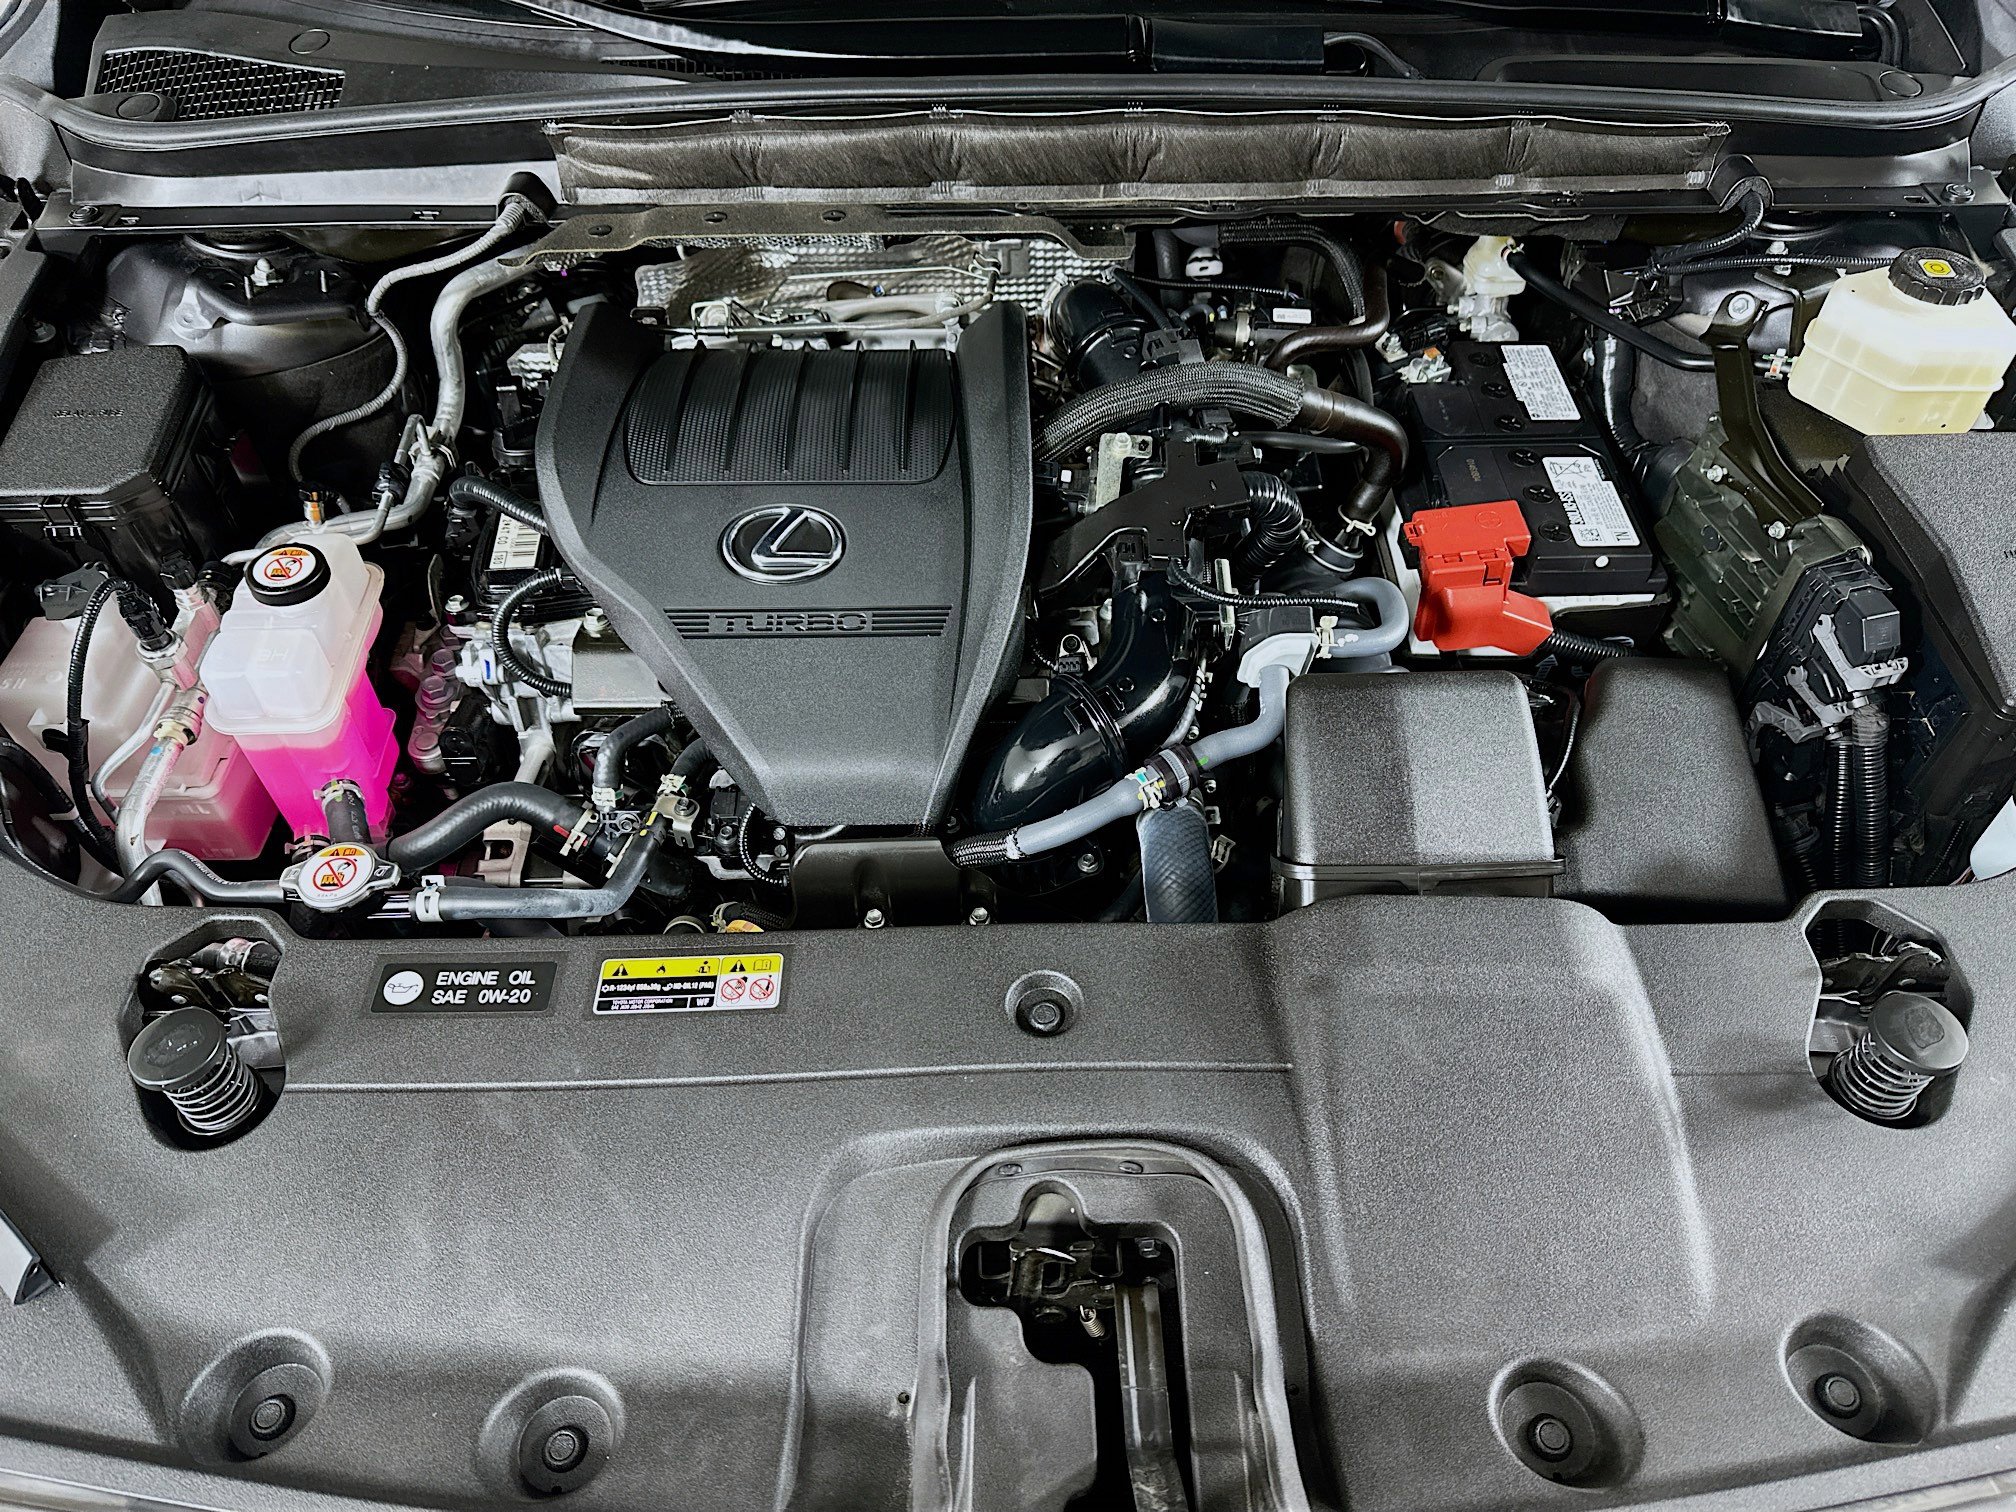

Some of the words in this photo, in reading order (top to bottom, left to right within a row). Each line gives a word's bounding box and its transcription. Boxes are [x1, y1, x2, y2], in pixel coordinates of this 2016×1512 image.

[714, 612, 868, 632] TURBO
[436, 970, 500, 986] ENGINE
[508, 970, 536, 985] OIL
[431, 989, 468, 1004] SAE
[477, 989, 532, 1004] 0W-20
